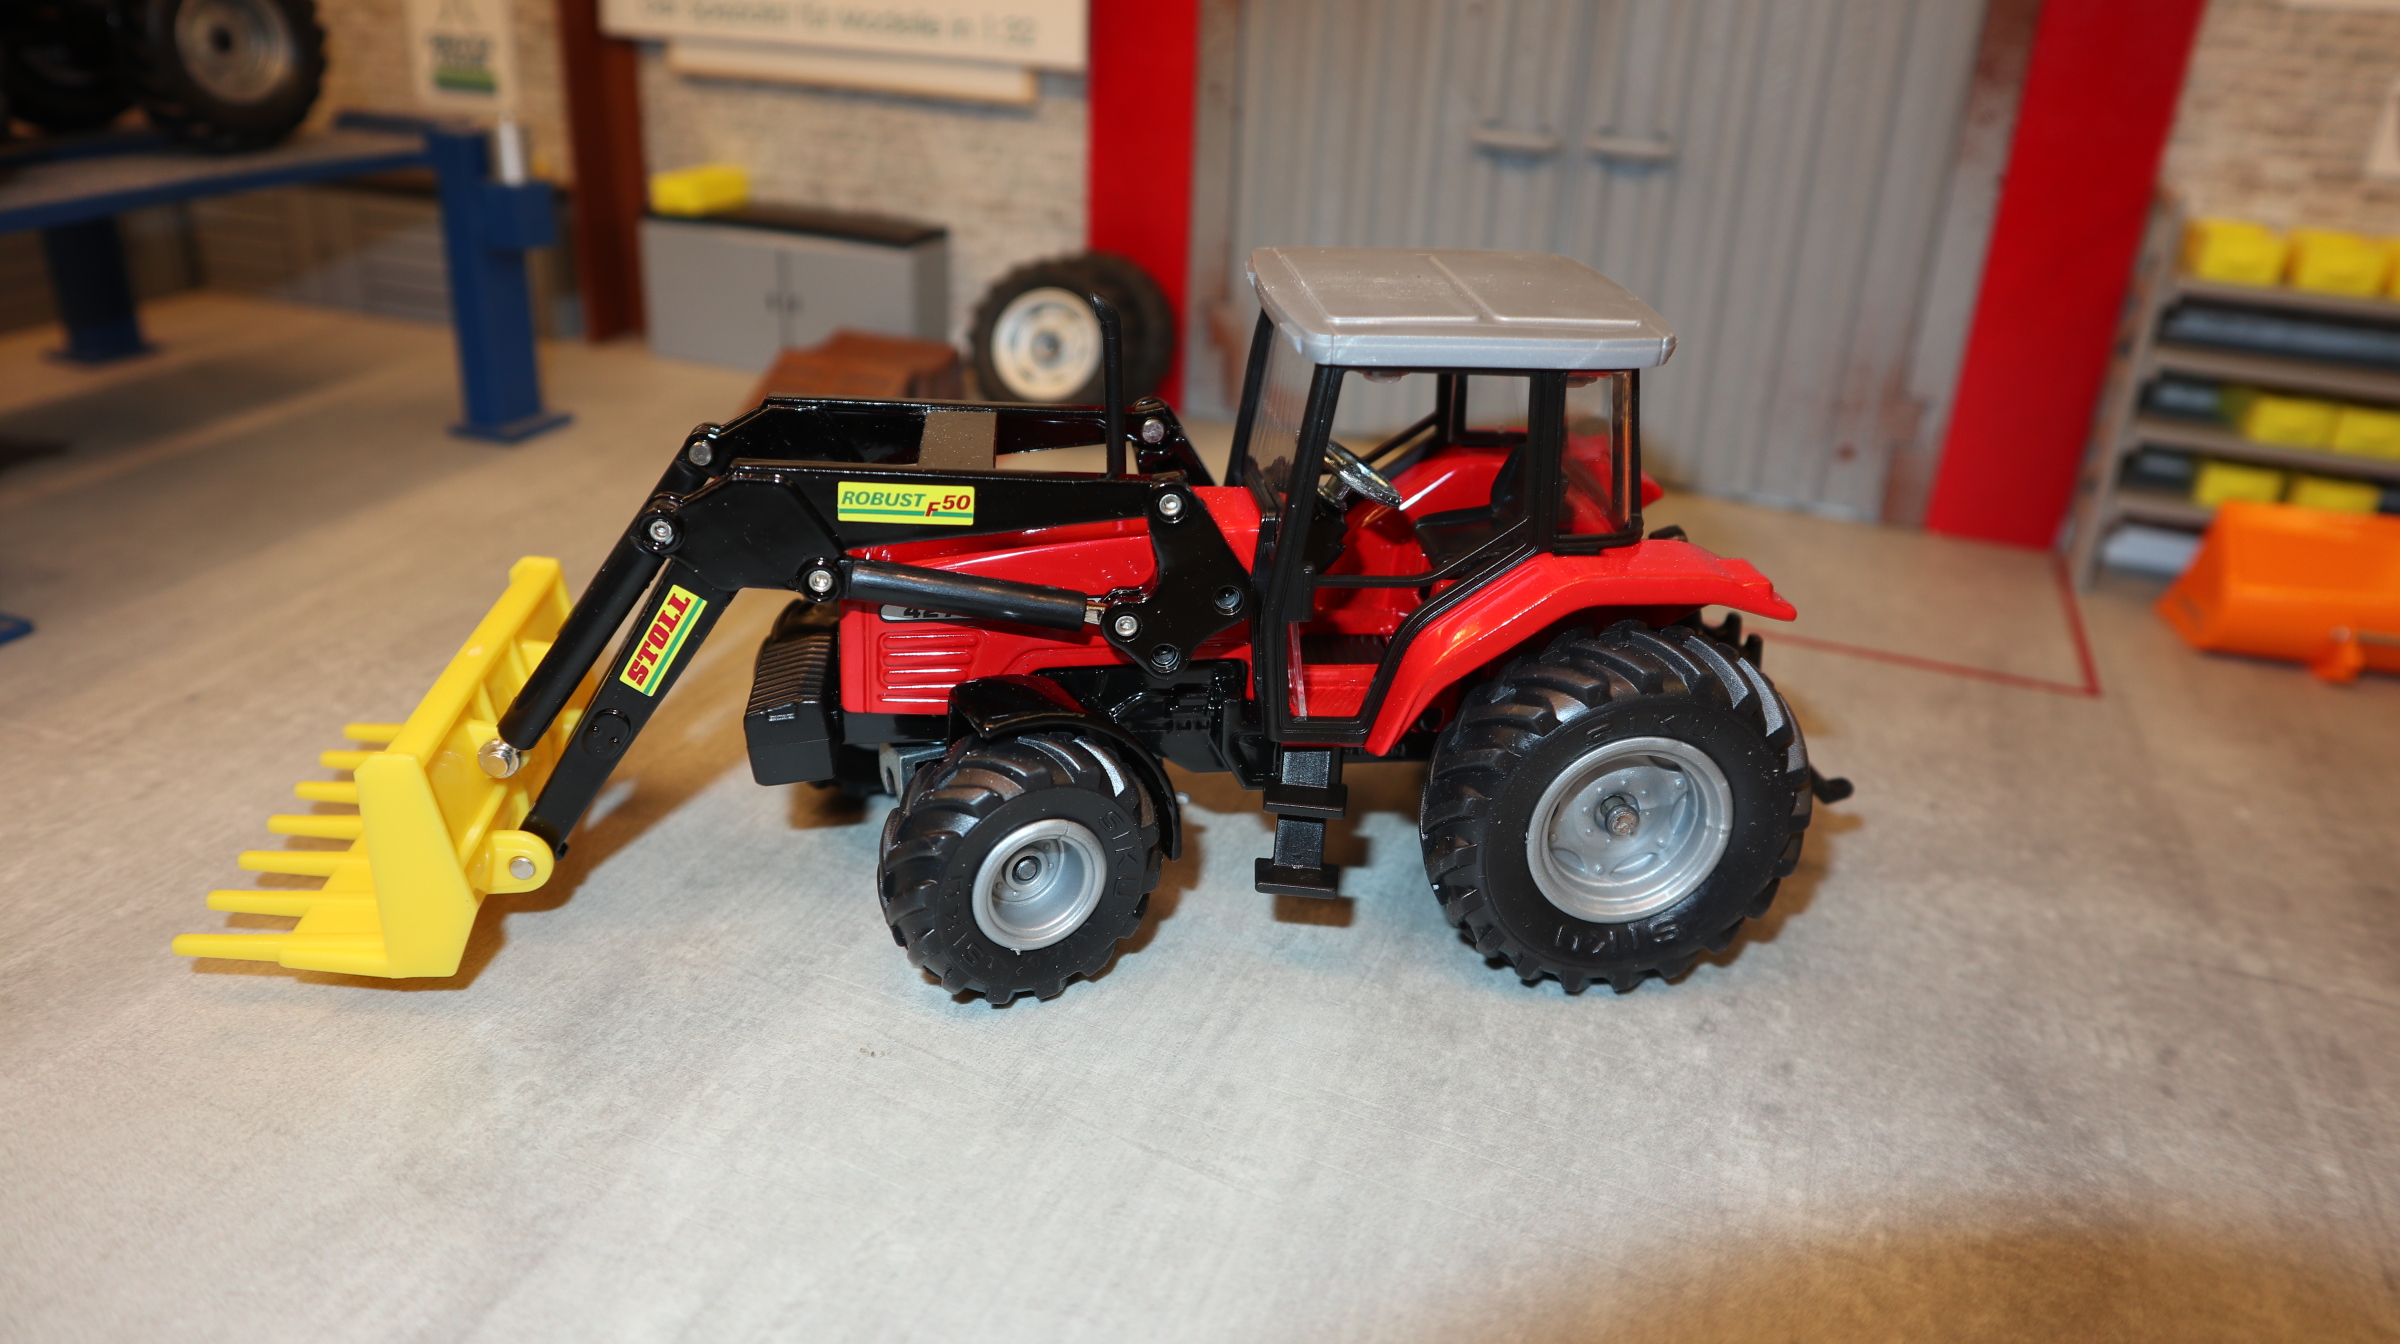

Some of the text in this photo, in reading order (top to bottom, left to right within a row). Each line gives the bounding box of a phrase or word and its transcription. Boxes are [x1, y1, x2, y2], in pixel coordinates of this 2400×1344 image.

[841, 491, 971, 517] ROBUST F50
[627, 593, 691, 686] STOLL
[1098, 811, 1138, 899] SIKU
[943, 876, 985, 967] SIKU
[1555, 915, 1679, 954] SIKU
